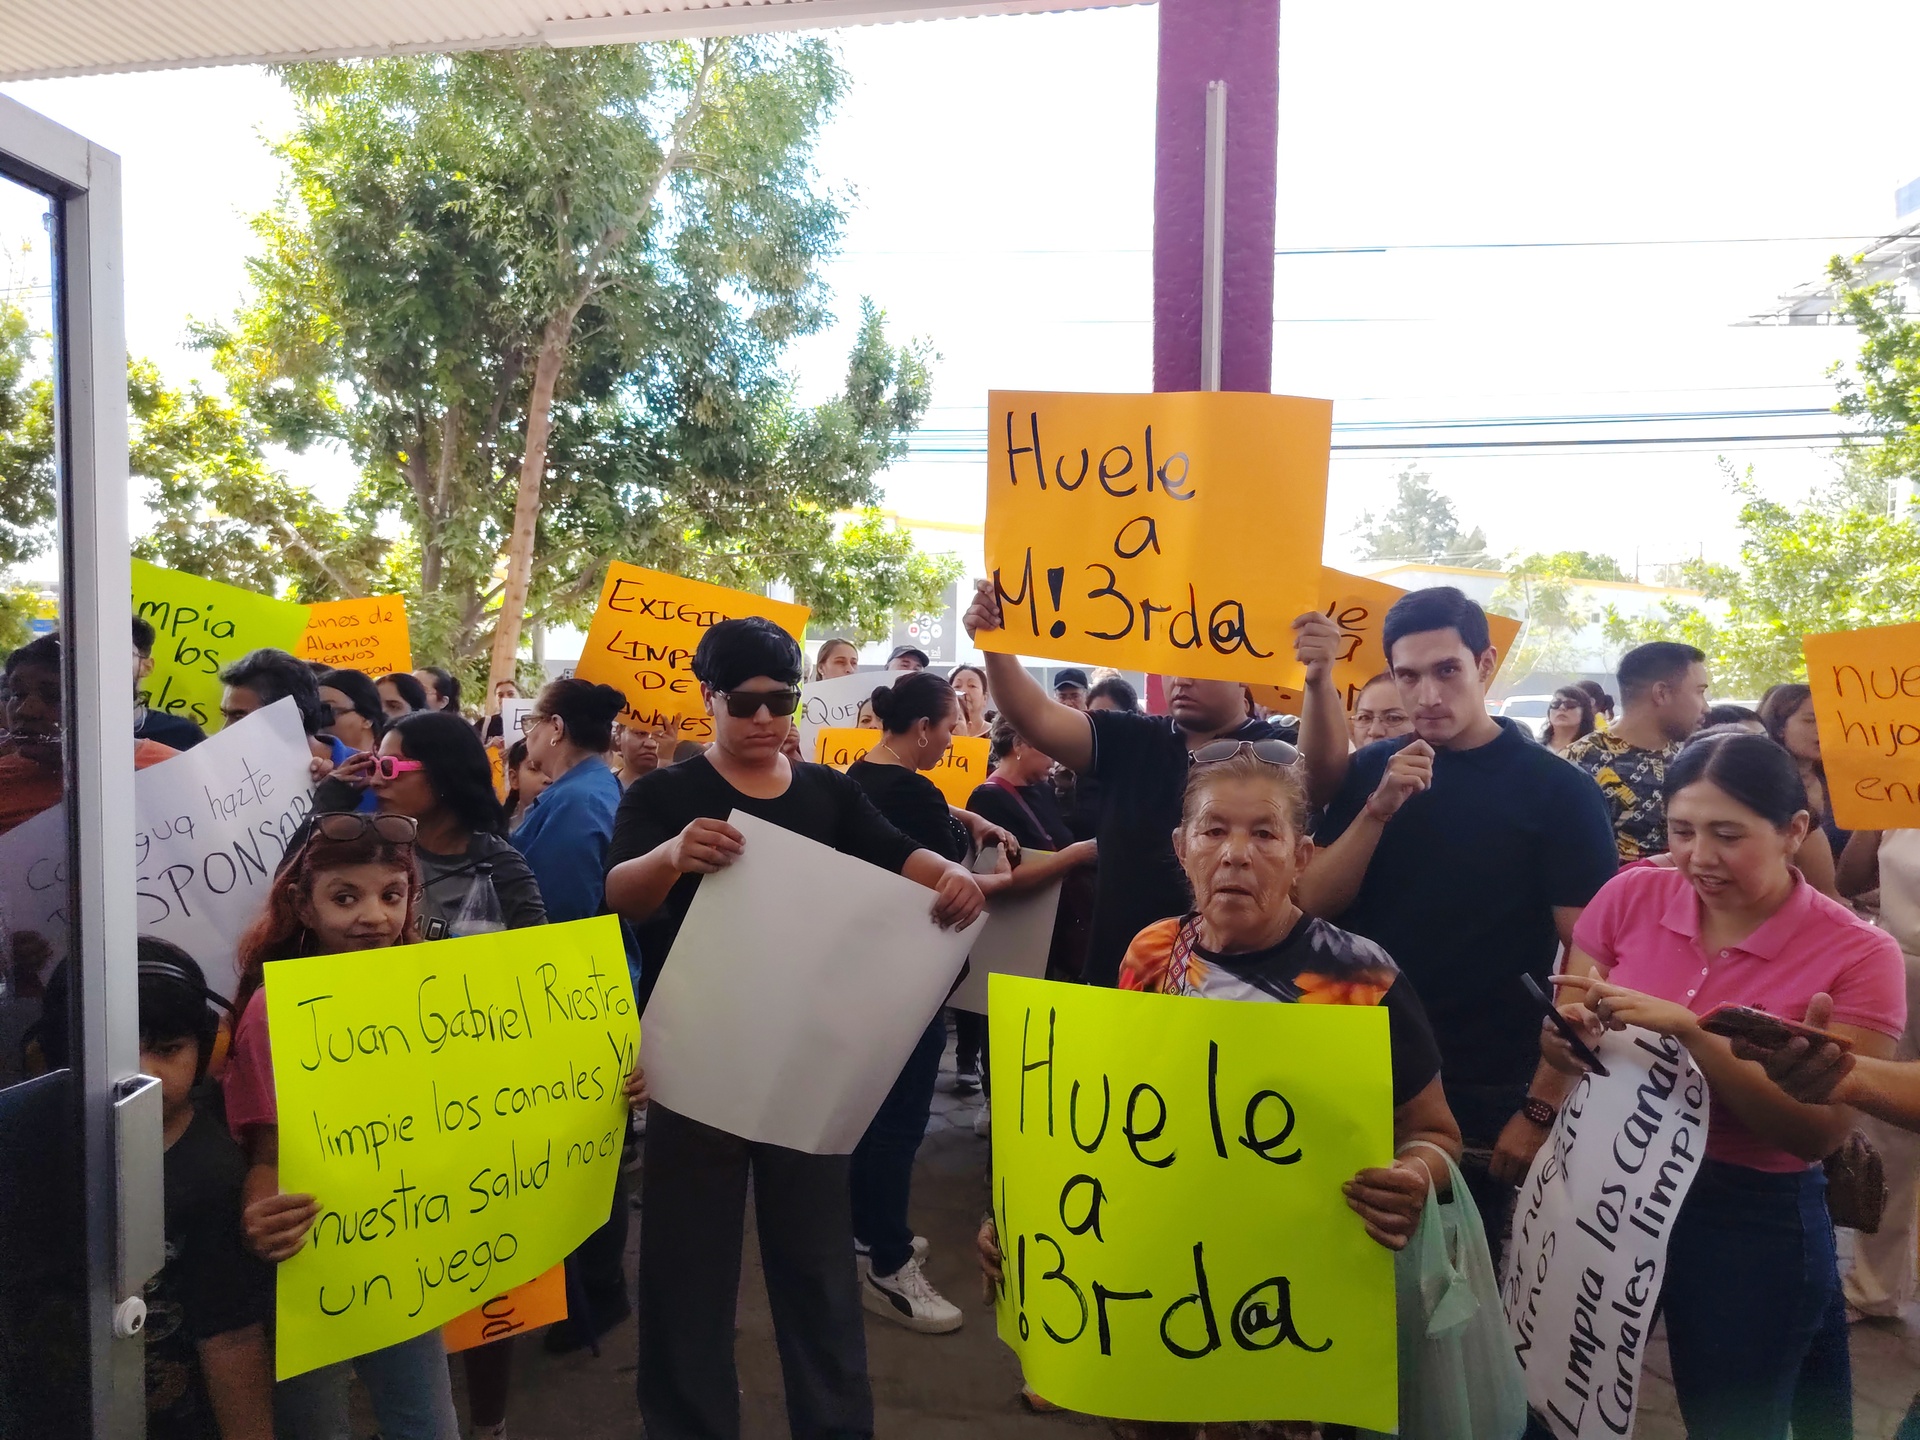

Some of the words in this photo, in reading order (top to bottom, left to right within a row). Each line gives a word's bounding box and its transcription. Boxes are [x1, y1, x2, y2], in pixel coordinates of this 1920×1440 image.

[1006, 411, 1196, 500] Huele
[1113, 516, 1161, 559] a
[369, 605, 394, 625] de
[608, 577, 731, 627] EXIGI
[174, 636, 220, 674] los
[307, 635, 380, 652] Alamos
[635, 671, 693, 693] DE
[205, 758, 275, 820] hazte
[1855, 777, 1920, 804] en
[298, 994, 412, 1071] Juan
[418, 973, 533, 1053] Gabriel
[535, 955, 631, 1023] Riestra
[313, 1110, 414, 1171] limpie
[432, 1080, 482, 1133] los
[494, 1060, 605, 1116] canales
[1020, 1006, 1303, 1168] Huele
[313, 1168, 451, 1249] nuestra
[1059, 1174, 1108, 1243] a
[1575, 1177, 1627, 1253] los
[318, 1274, 393, 1316] un
[408, 1232, 518, 1317] juego
